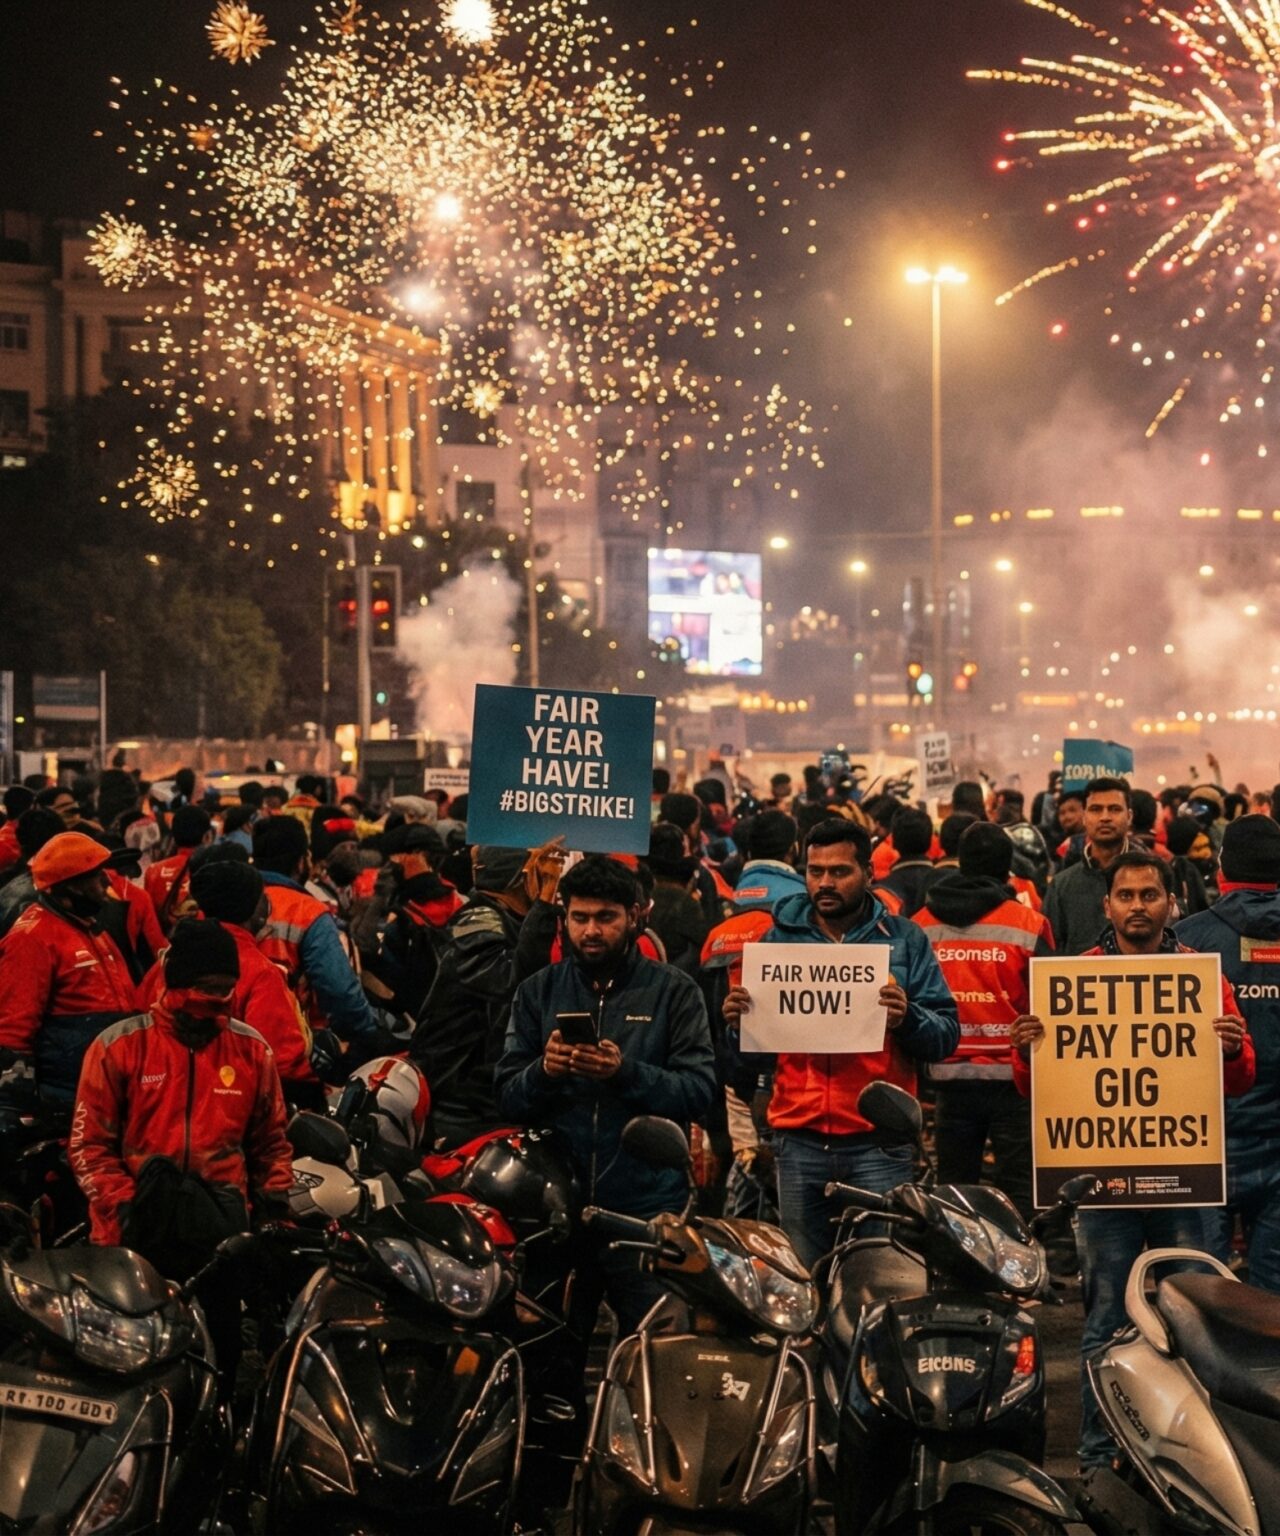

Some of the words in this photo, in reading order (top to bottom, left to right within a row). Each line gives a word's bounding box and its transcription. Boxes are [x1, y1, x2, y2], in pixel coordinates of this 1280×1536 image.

[534, 694, 599, 725] FAIR
[525, 726, 603, 757] YEAR
[522, 758, 609, 789] HAVE!
[500, 790, 634, 819] #BIGSTRIKE!
[761, 964, 803, 982] FAIR
[809, 965, 875, 983] WAGES
[779, 990, 851, 1015] NOW!
[1049, 974, 1202, 1016] BETTER
[1056, 1024, 1118, 1059] PAY
[1131, 1023, 1197, 1058] FOR
[1095, 1067, 1159, 1108] GIG
[1045, 1115, 1208, 1149] WORKERS!
